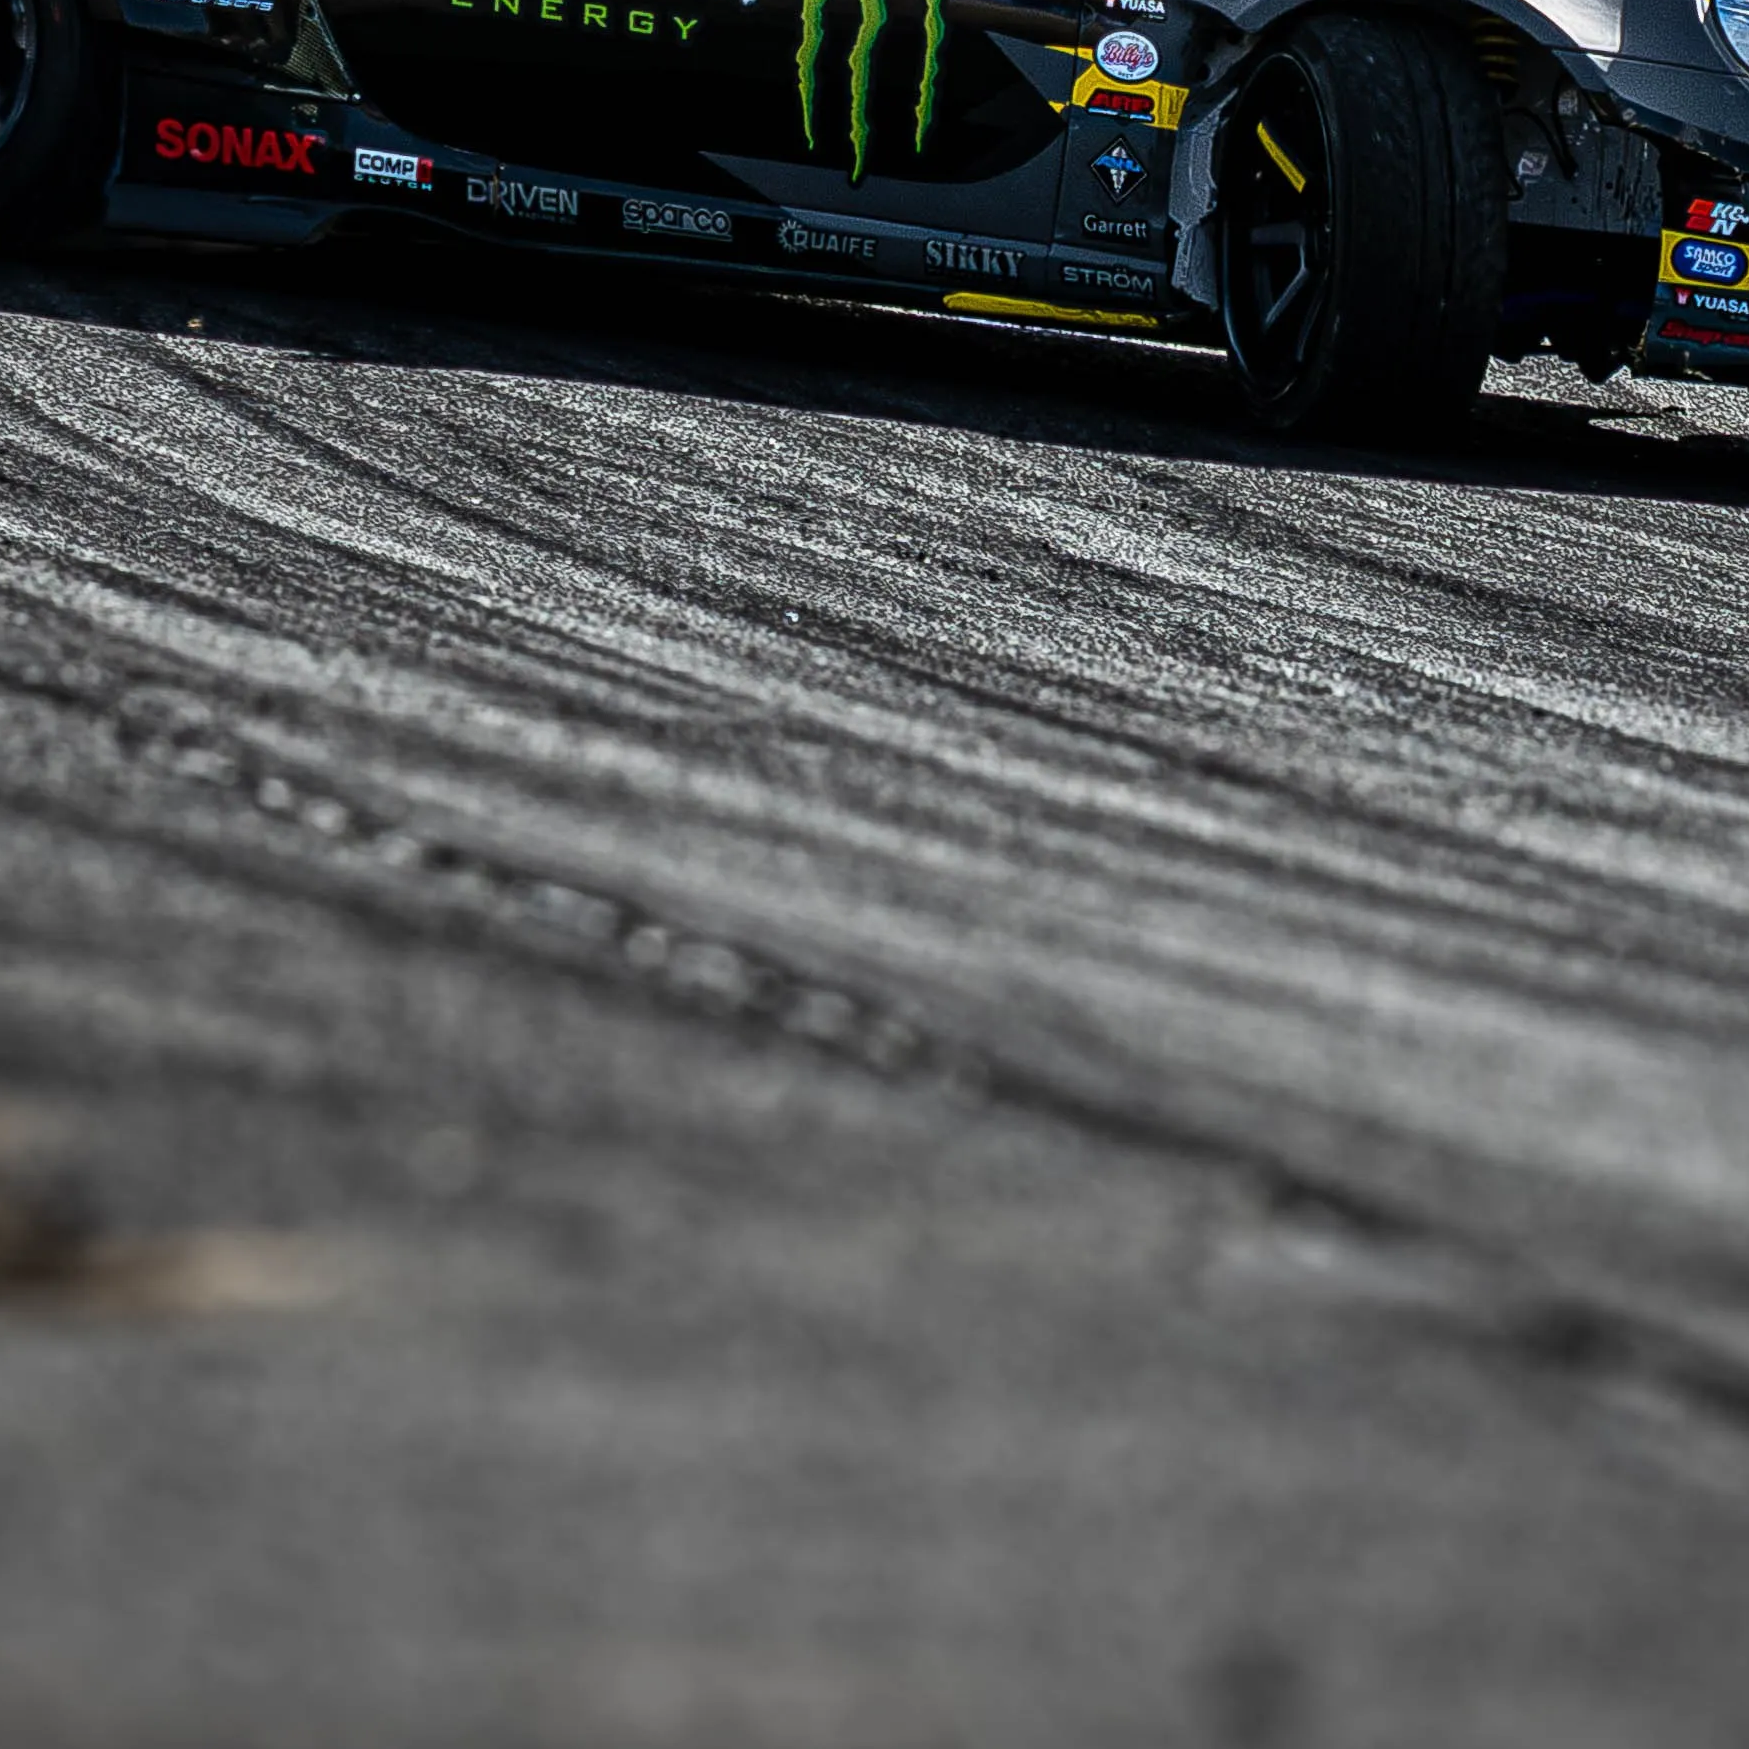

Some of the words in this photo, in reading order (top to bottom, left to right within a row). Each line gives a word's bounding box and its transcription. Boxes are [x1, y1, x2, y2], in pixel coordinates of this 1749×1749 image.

[1100, 40, 1155, 73] Billy's
[155, 118, 317, 175] SONAX
[357, 153, 416, 175] COMP
[353, 172, 433, 192] CLUTCH
[466, 176, 579, 216] DRIVEN
[623, 198, 732, 241] sparco
[1083, 213, 1148, 238] Garrett
[793, 229, 878, 259] QUAIFE
[1683, 245, 1736, 267] SAMCO
[925, 239, 1026, 279] SIKKY
[1696, 260, 1732, 277] sport
[1063, 266, 1154, 294] STRÖM
[1693, 293, 1749, 315] YUASA
